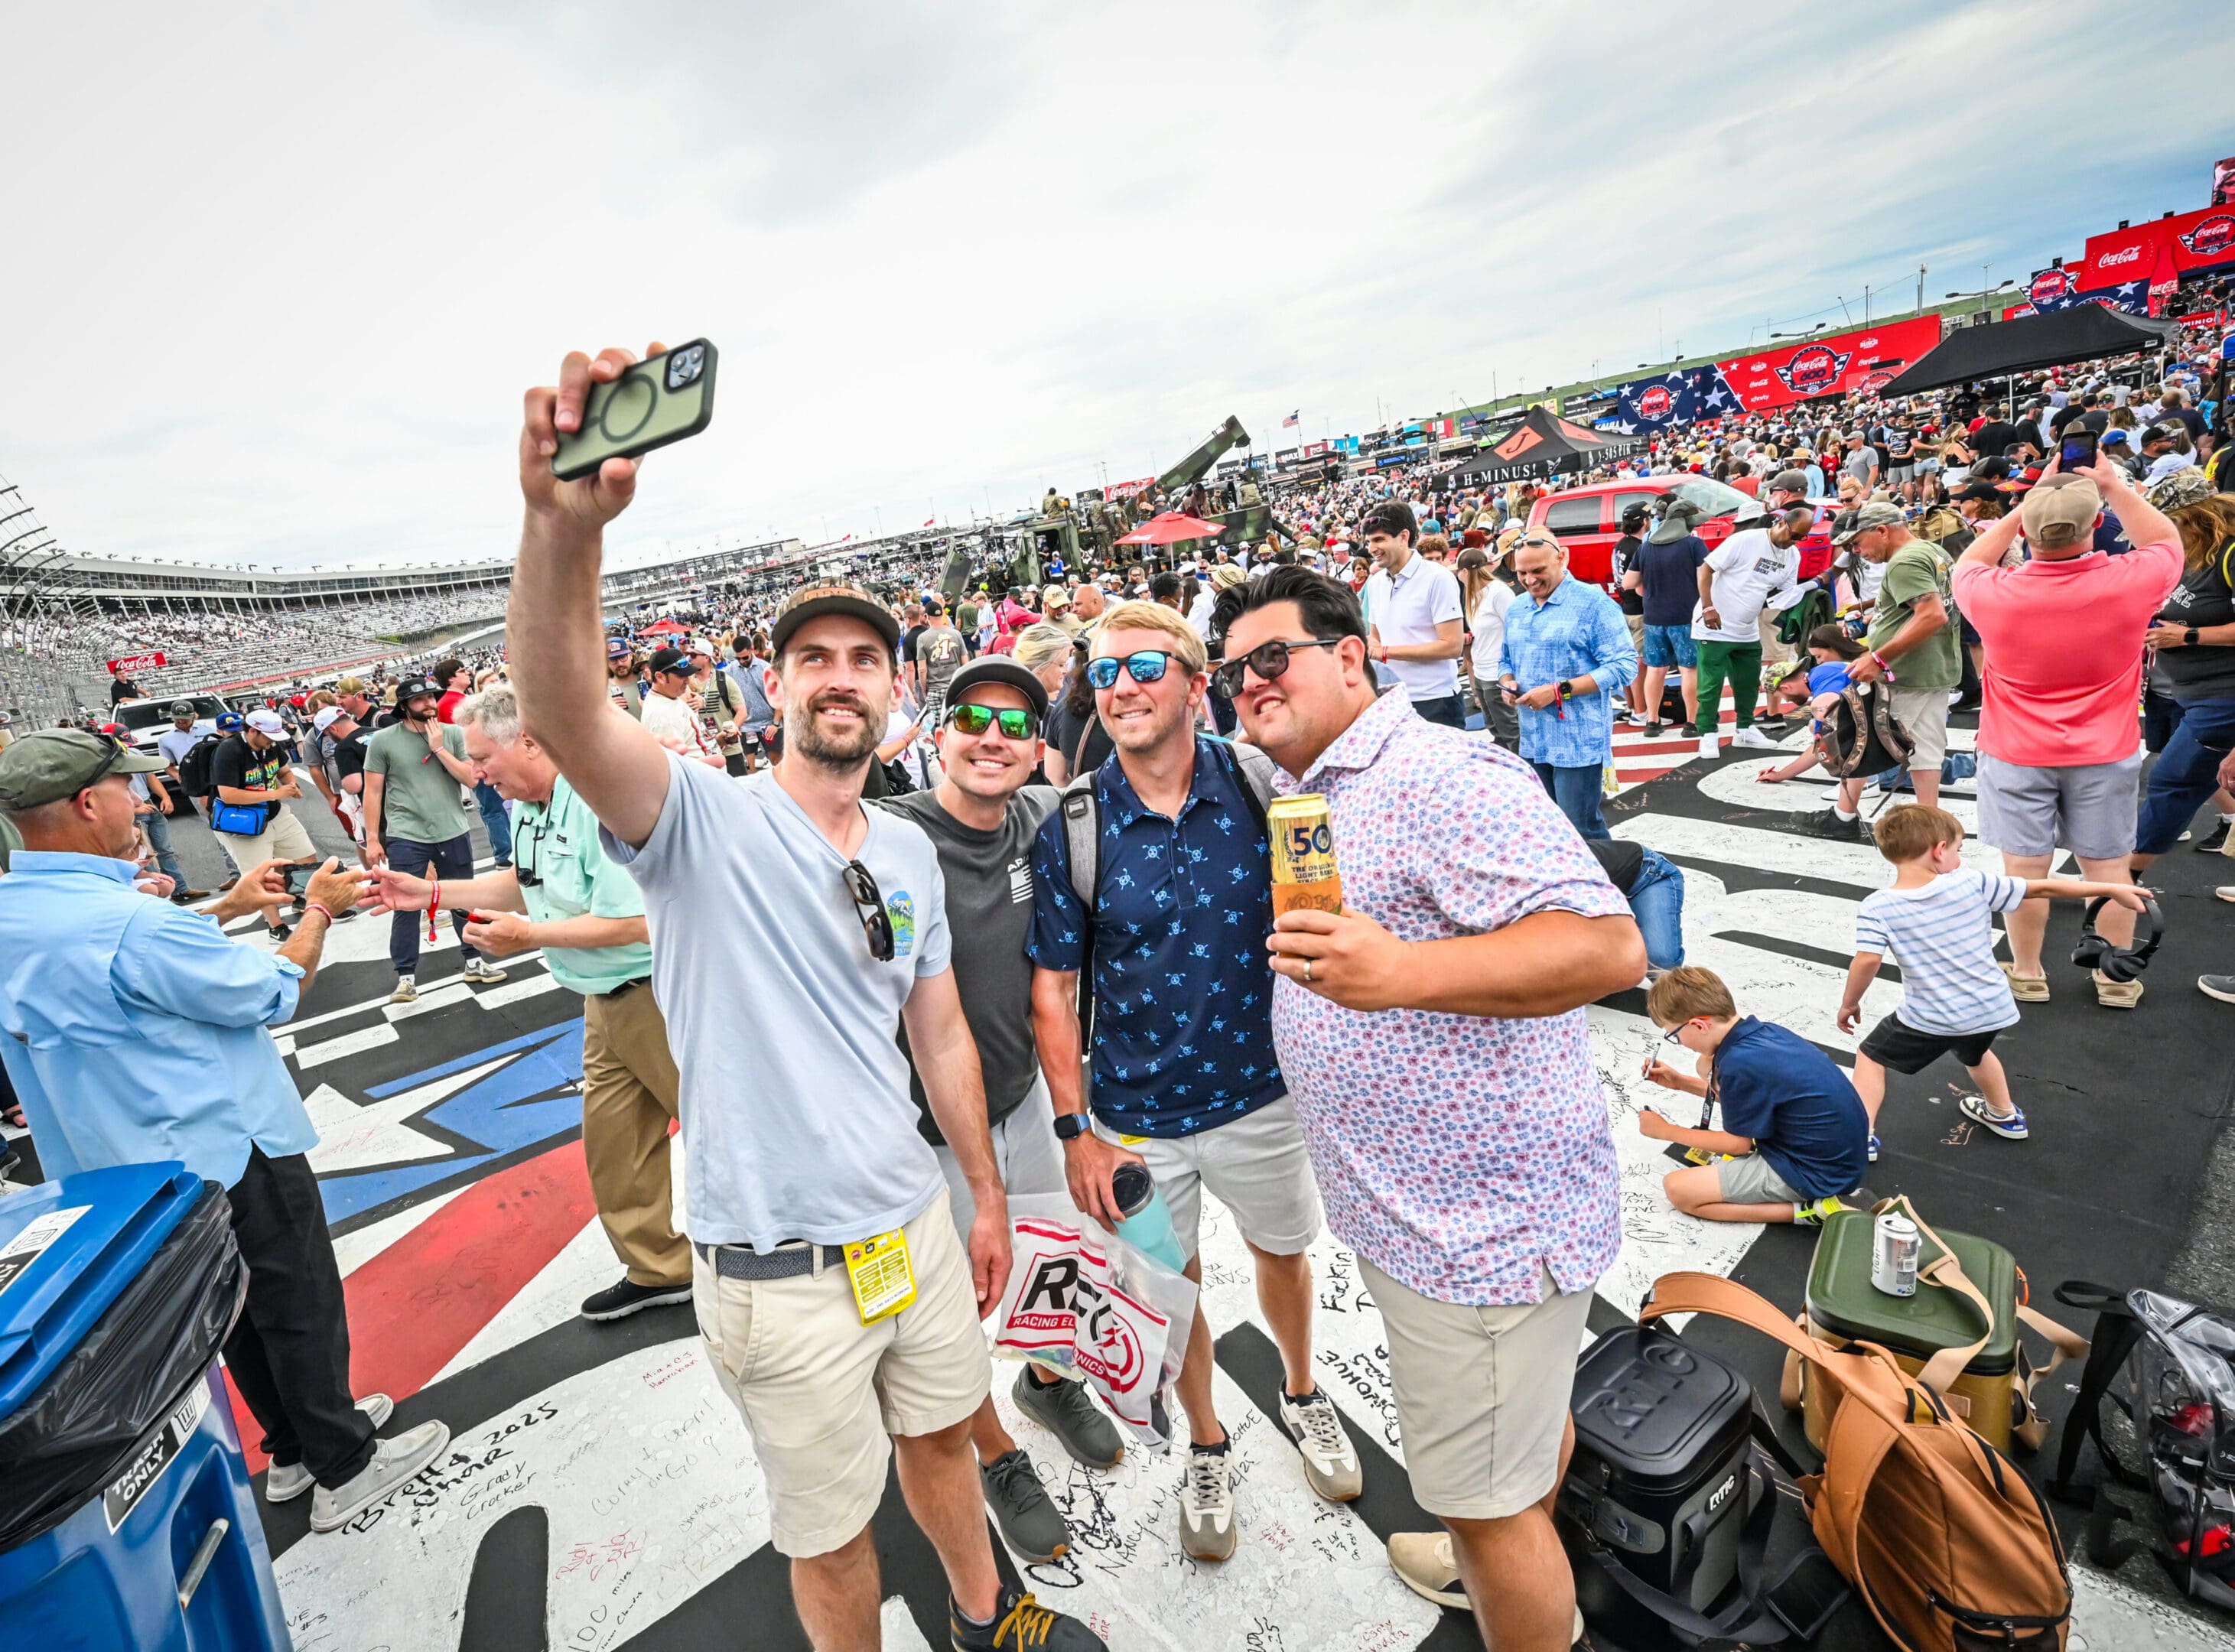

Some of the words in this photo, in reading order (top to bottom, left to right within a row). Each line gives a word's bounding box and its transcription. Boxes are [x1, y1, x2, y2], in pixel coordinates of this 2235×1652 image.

[2098, 245, 2142, 268] Coca-Cola
[2179, 317, 2216, 328] MINIO
[1793, 354, 1830, 372] Coca-Cola
[1800, 368, 1827, 381] 600
[1464, 463, 1537, 486] H-MINUS!
[939, 639, 951, 662] 1
[116, 654, 157, 671] Coca-Cola
[1013, 1316, 1058, 1328] RACING
[483, 1401, 558, 1446] 2025
[122, 1445, 164, 1501] ONLY
[460, 1461, 526, 1506] Grady
[467, 1472, 538, 1520] Crocker
[1709, 1475, 1736, 1512] RTIC
[1095, 1519, 1170, 1579] NANCY
